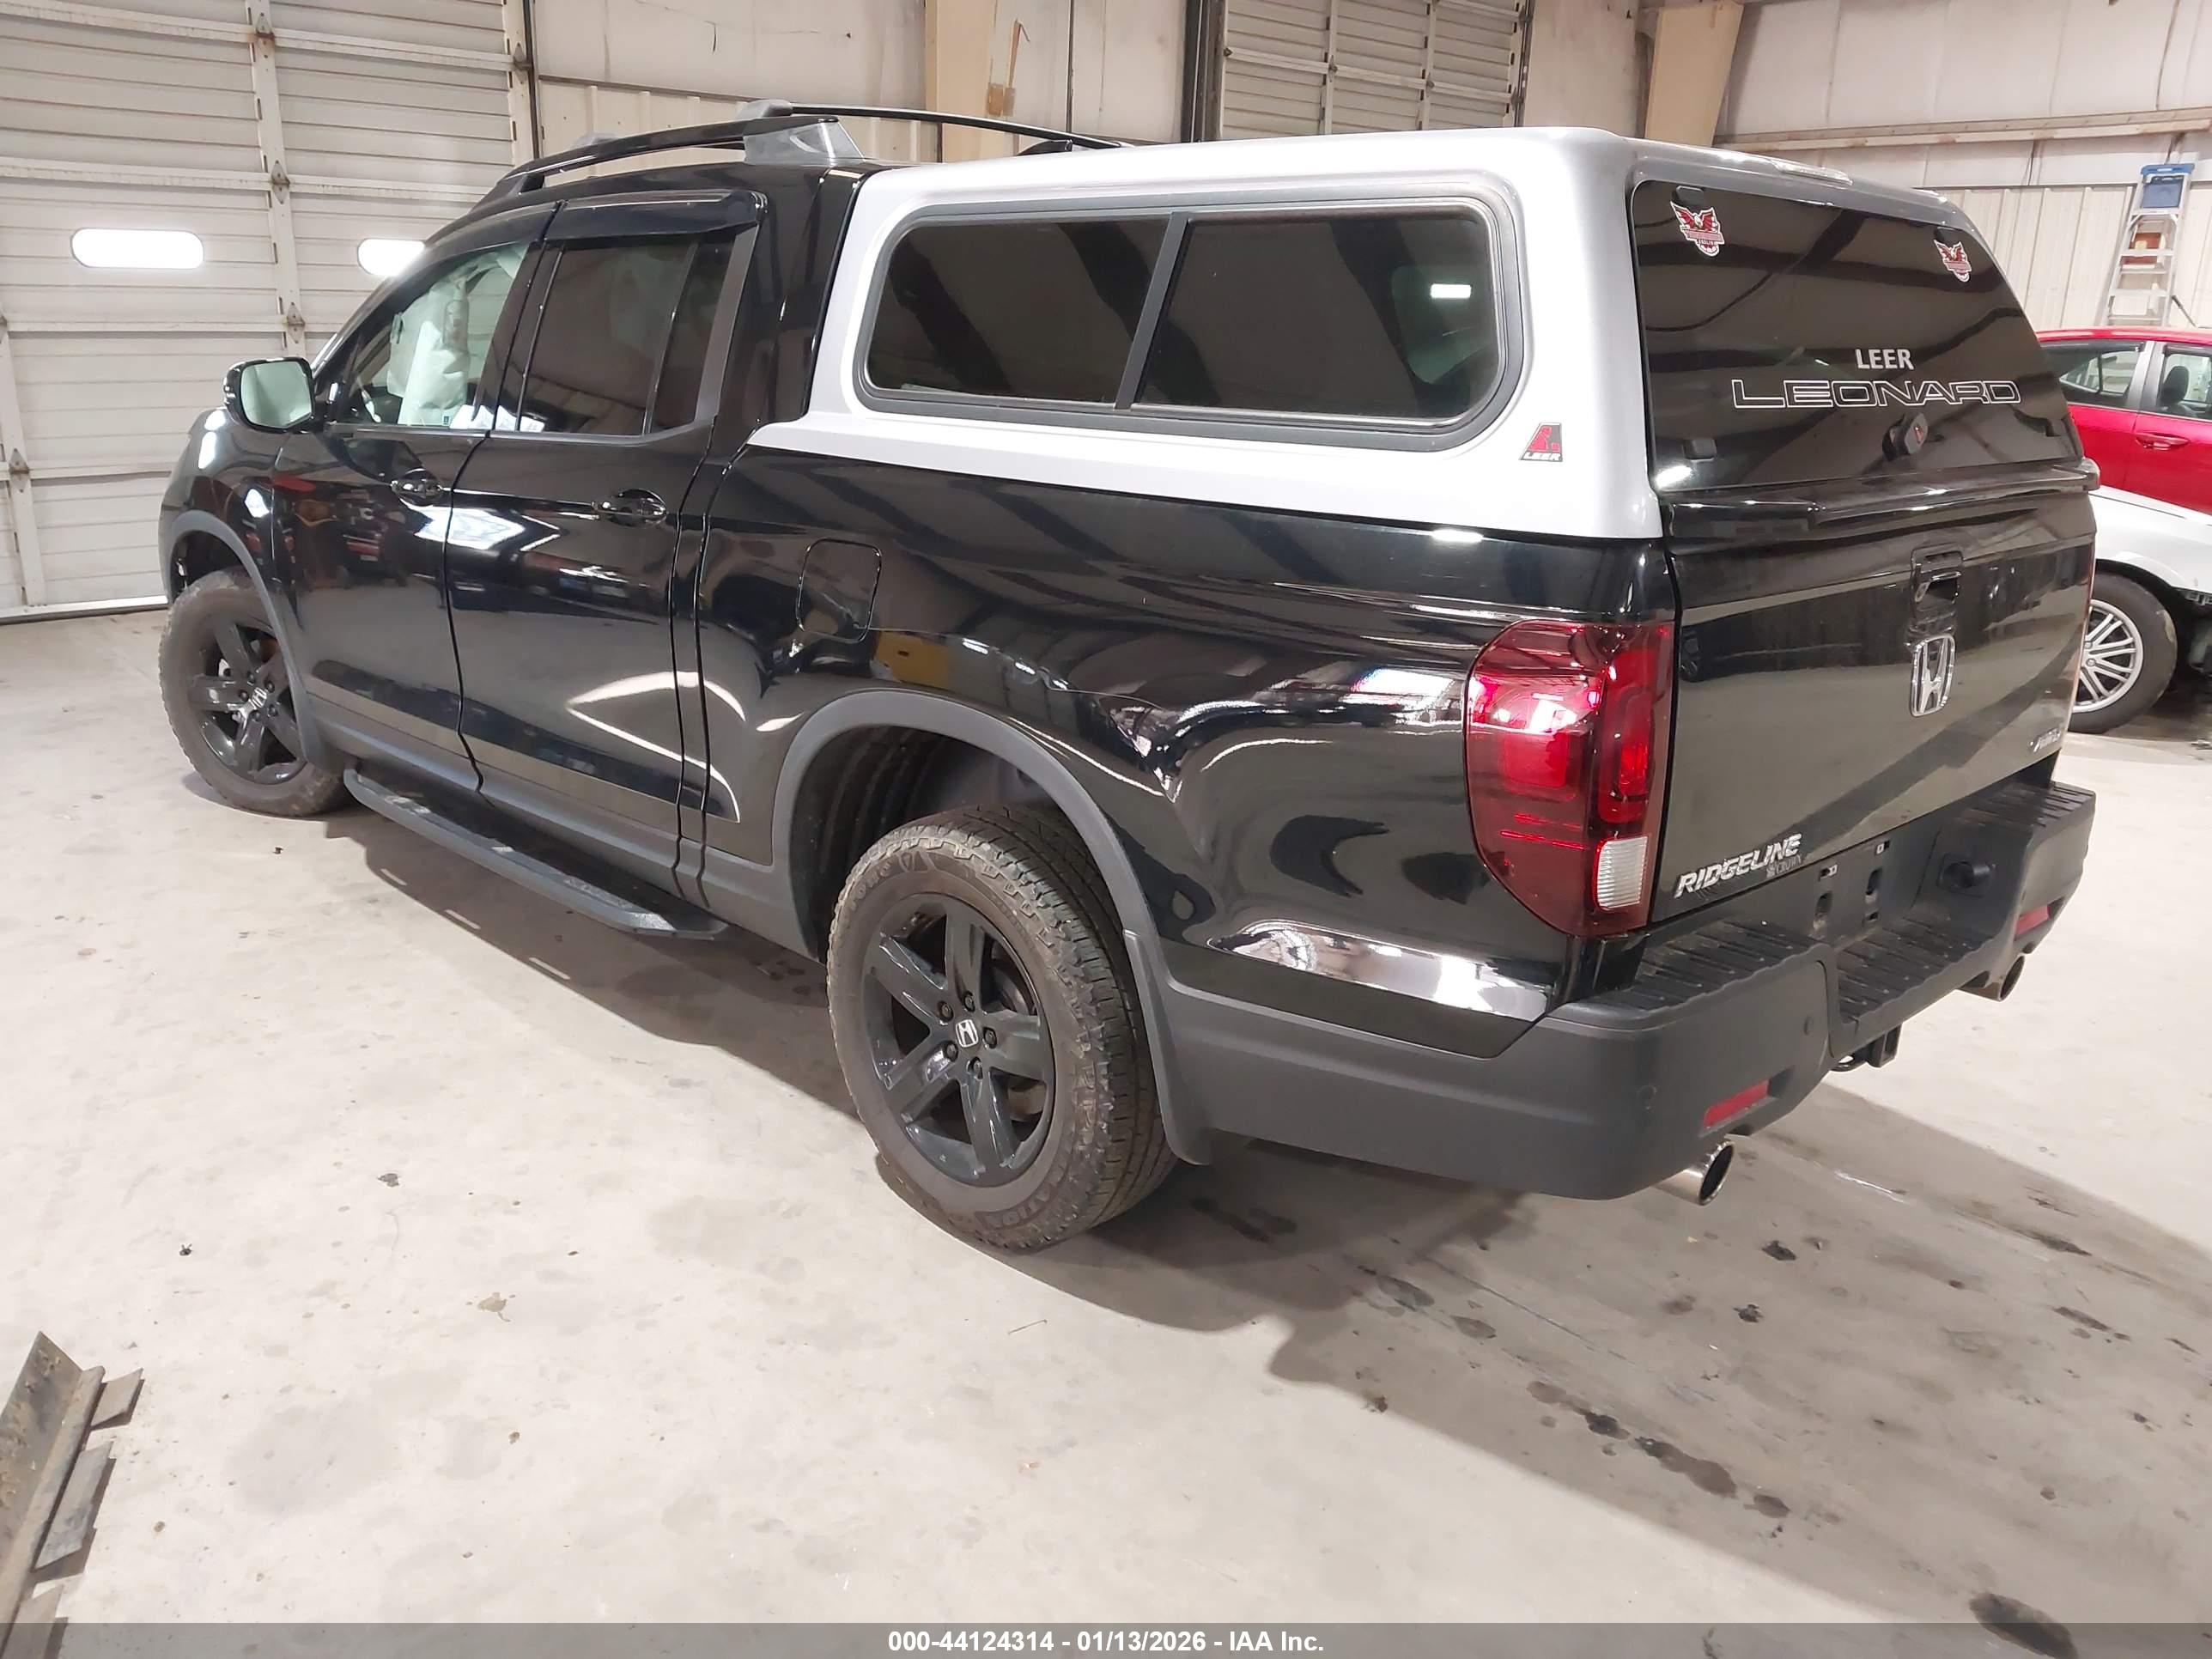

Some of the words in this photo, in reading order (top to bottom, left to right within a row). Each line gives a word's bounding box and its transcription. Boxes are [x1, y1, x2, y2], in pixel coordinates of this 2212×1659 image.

[1855, 348, 1915, 370] LEER
[1730, 379, 2021, 409] LEONARD
[1674, 833, 1802, 898] RIDGELINE
